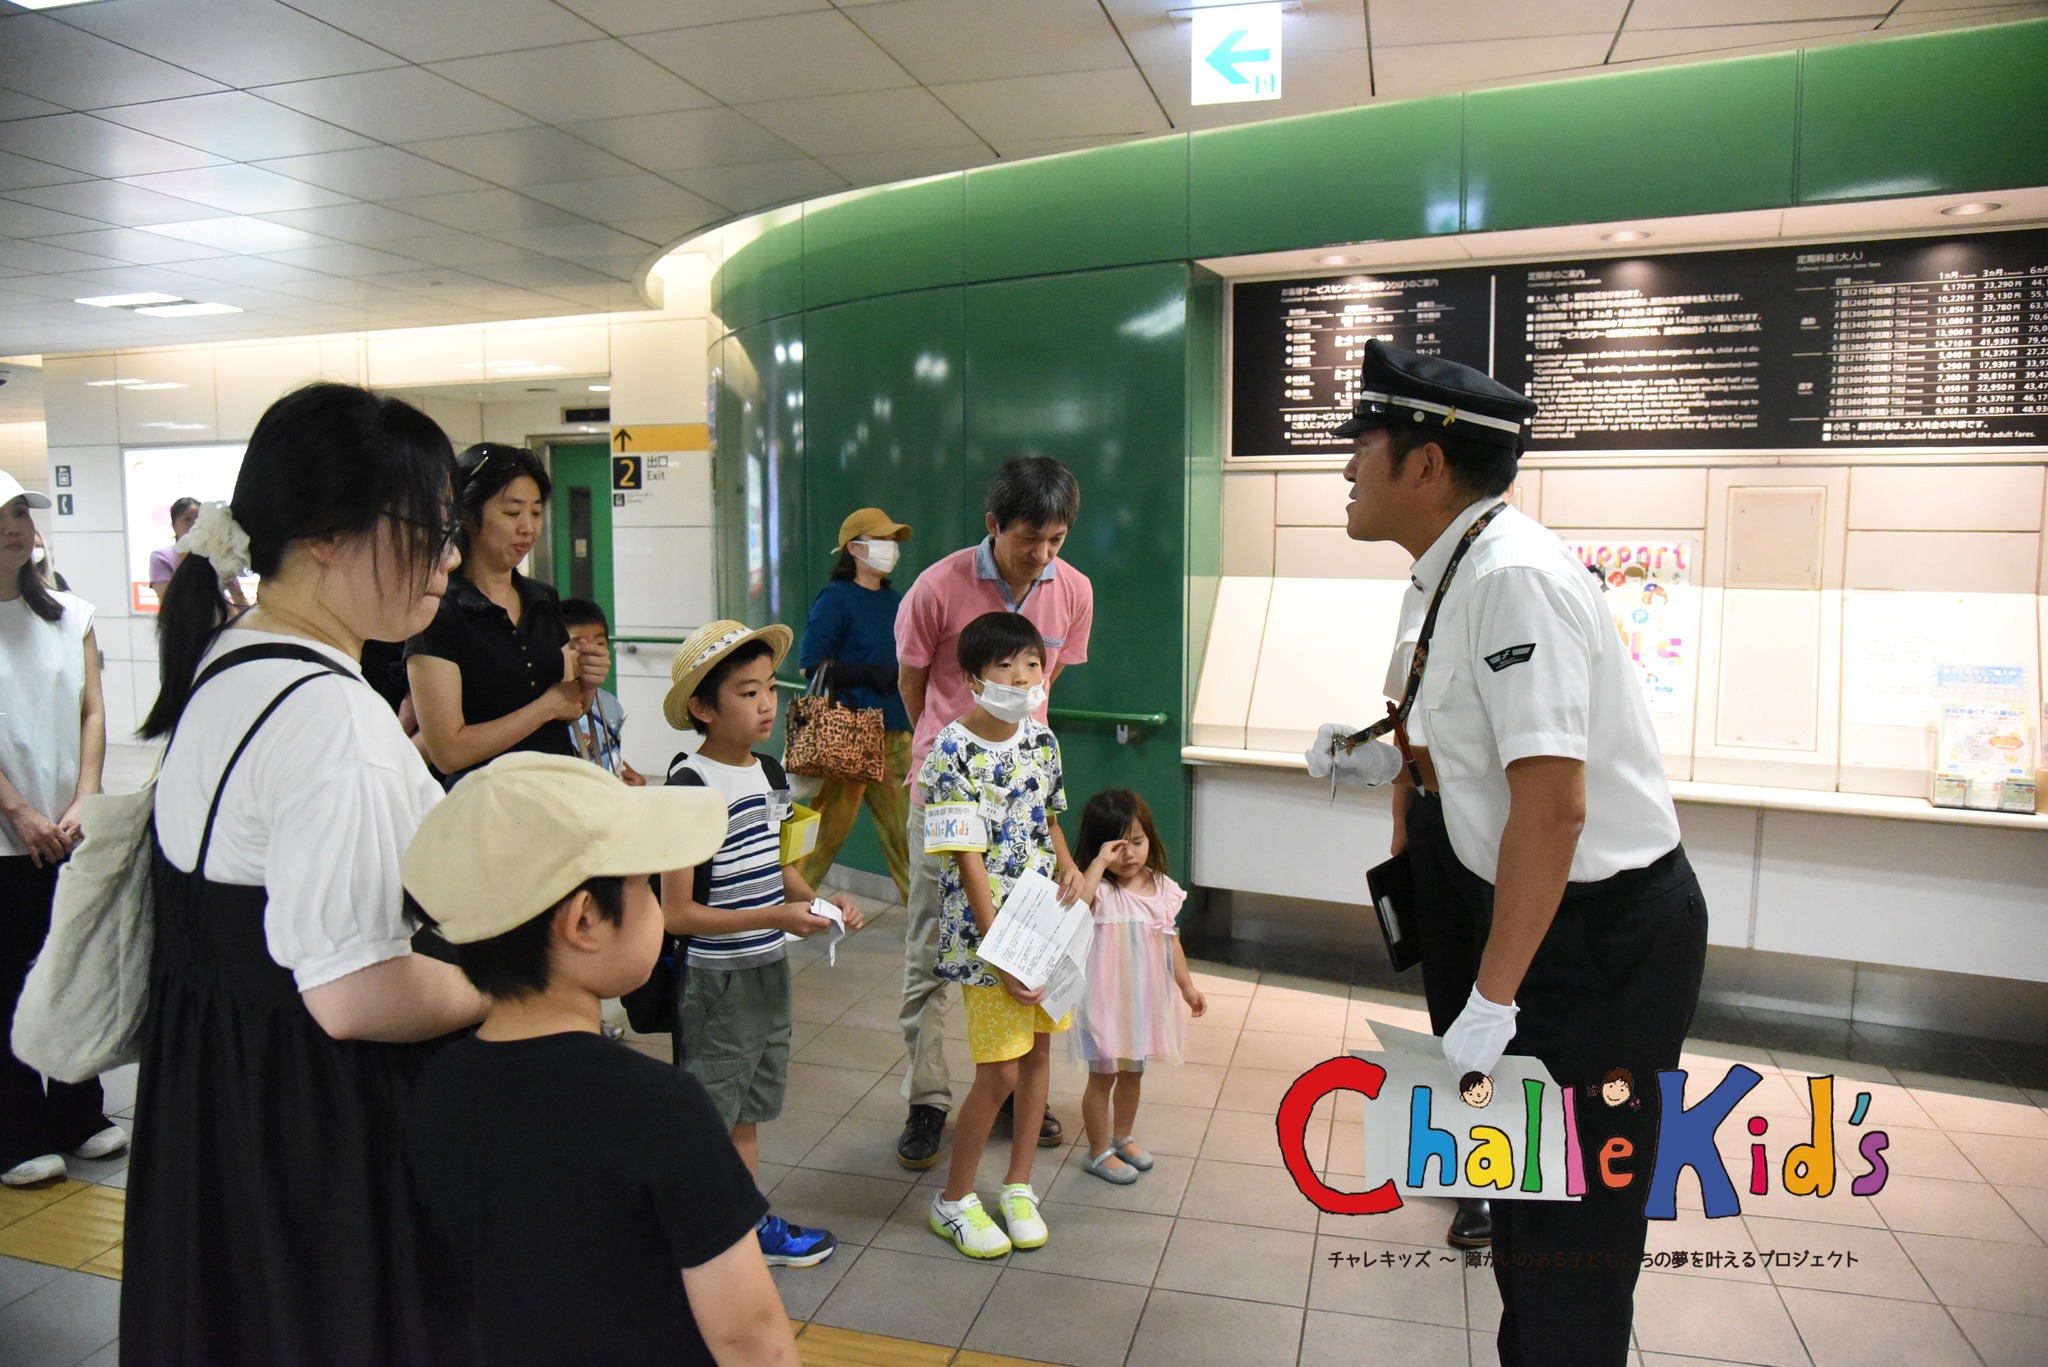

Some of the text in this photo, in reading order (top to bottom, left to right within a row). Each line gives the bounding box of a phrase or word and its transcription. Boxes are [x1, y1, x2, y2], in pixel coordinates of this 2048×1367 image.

[1796, 252, 1863, 264] 定期料金(大人)
[647, 456, 668, 468] 出口
[619, 459, 635, 487] 2
[647, 471, 665, 481] Exit
[1570, 544, 1686, 570] upport
